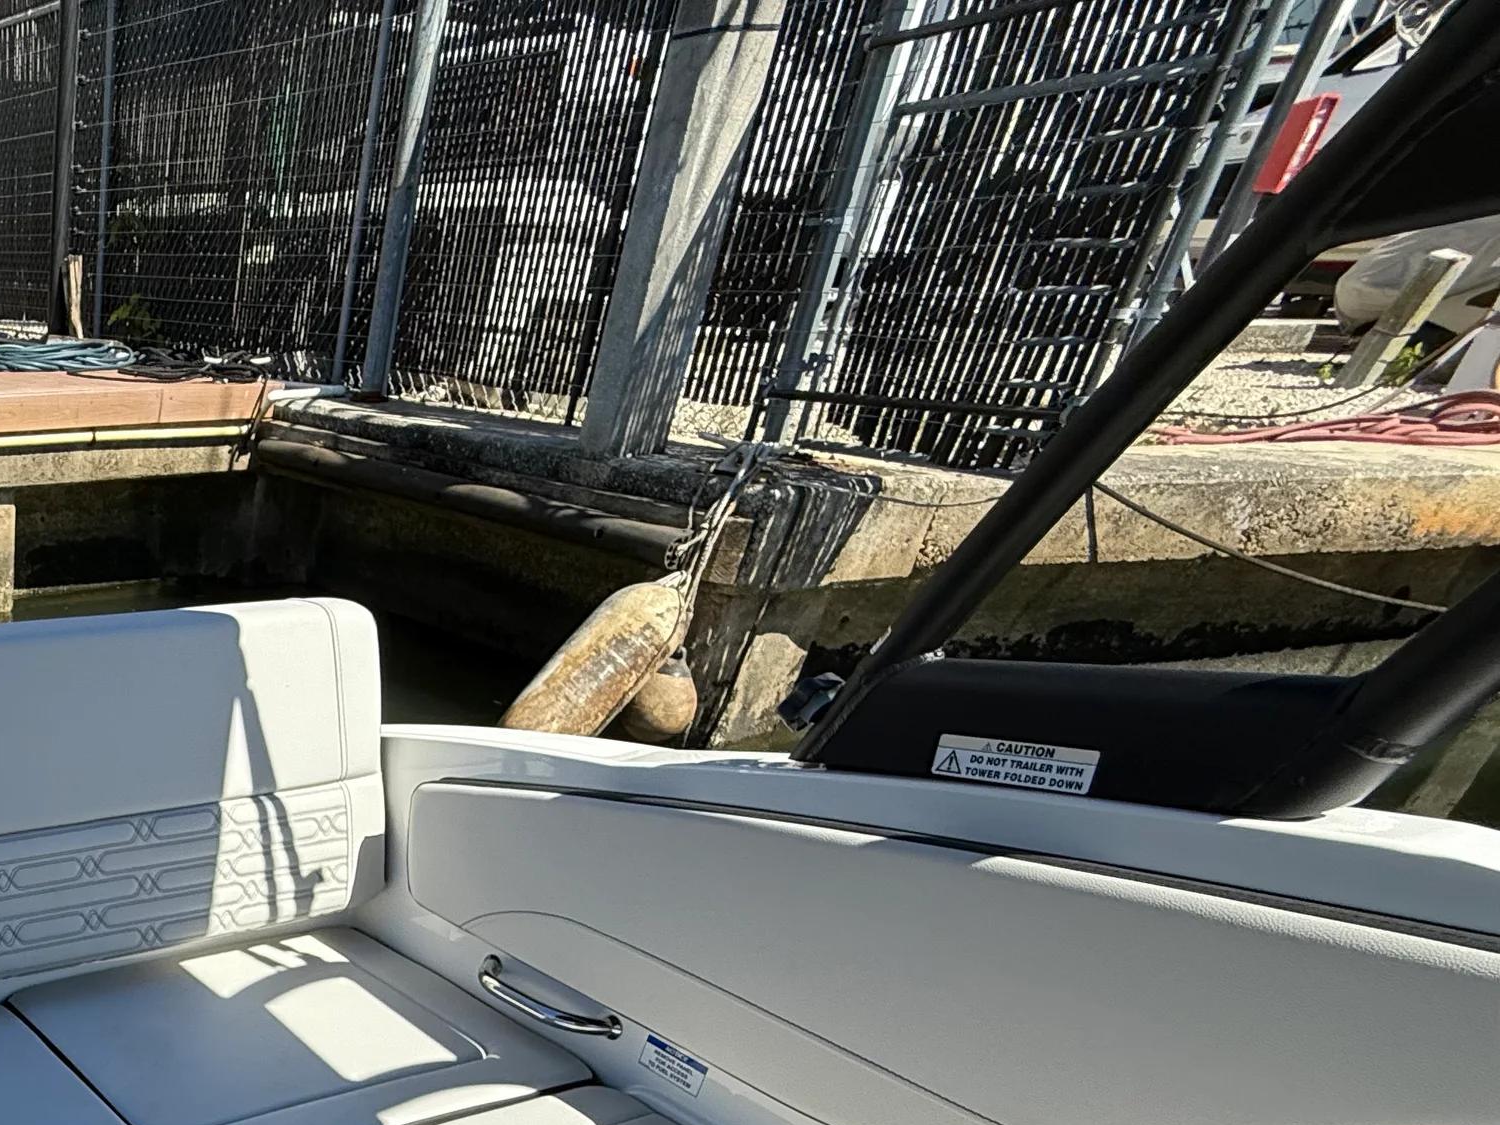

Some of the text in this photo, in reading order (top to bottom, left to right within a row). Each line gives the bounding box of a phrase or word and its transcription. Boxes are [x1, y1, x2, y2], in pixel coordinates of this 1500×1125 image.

[996, 742, 1055, 758] CAUTION
[970, 754, 1084, 778] DO NOT TRAILER WITH
[965, 767, 1084, 791] TOWER FOLDED DOWN
[654, 1049, 676, 1064] REMOVE
[665, 1046, 689, 1062] NOTICE
[655, 1057, 688, 1079] FOR ACCESS
[670, 1073, 691, 1089] SYSTEM
